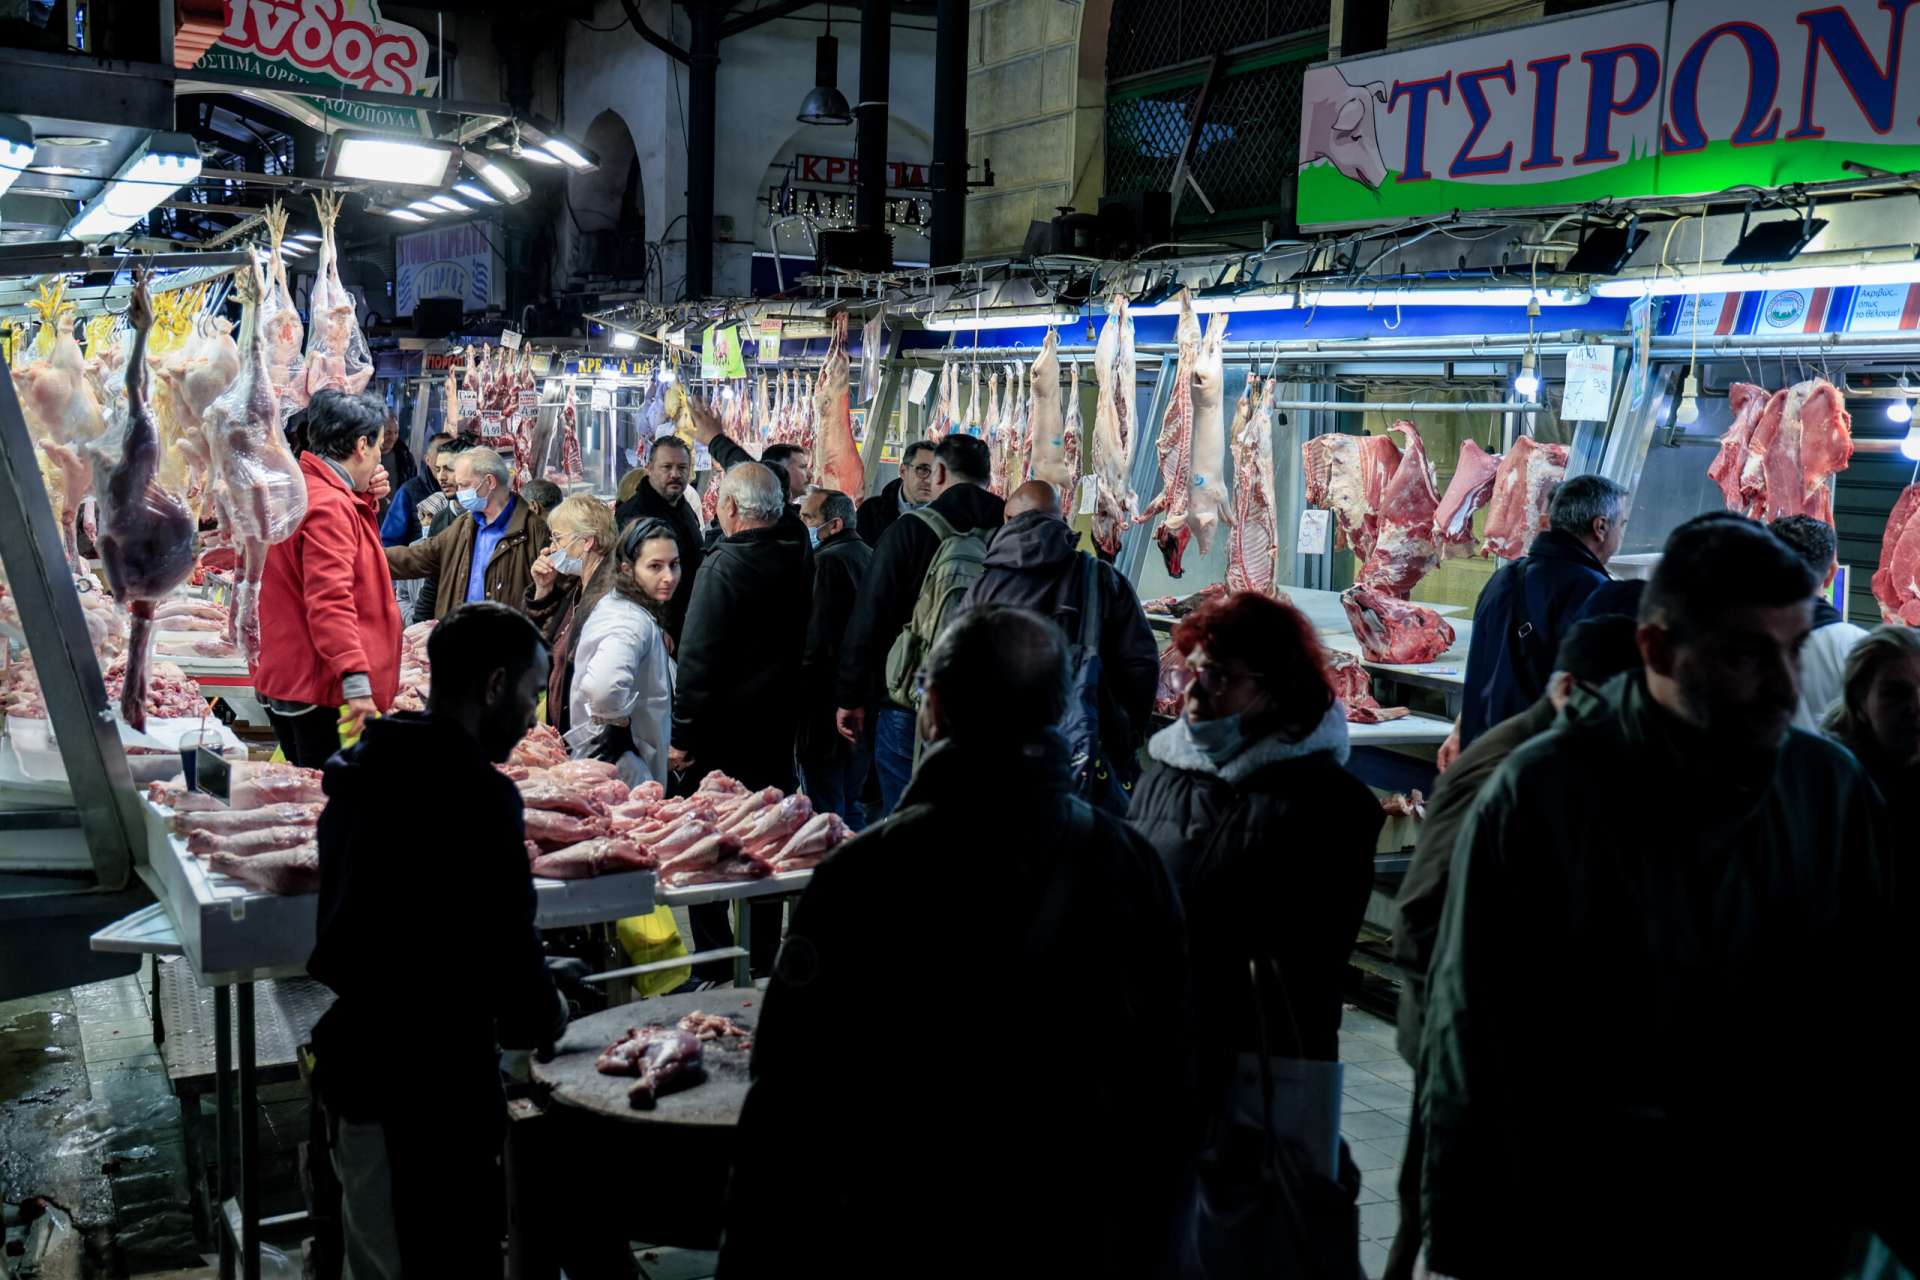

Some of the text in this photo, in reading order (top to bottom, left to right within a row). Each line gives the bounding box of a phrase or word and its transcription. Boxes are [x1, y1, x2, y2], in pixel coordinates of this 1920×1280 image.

[192, 54, 260, 75] ΟΣΤΙΜΑ
[224, 0, 418, 96] ινδος
[1388, 0, 1920, 182] ΤΣΙΡΩΝ
[803, 155, 924, 188] ΚΡΕΤΑ
[578, 358, 628, 373] ΚΡΕΑ
